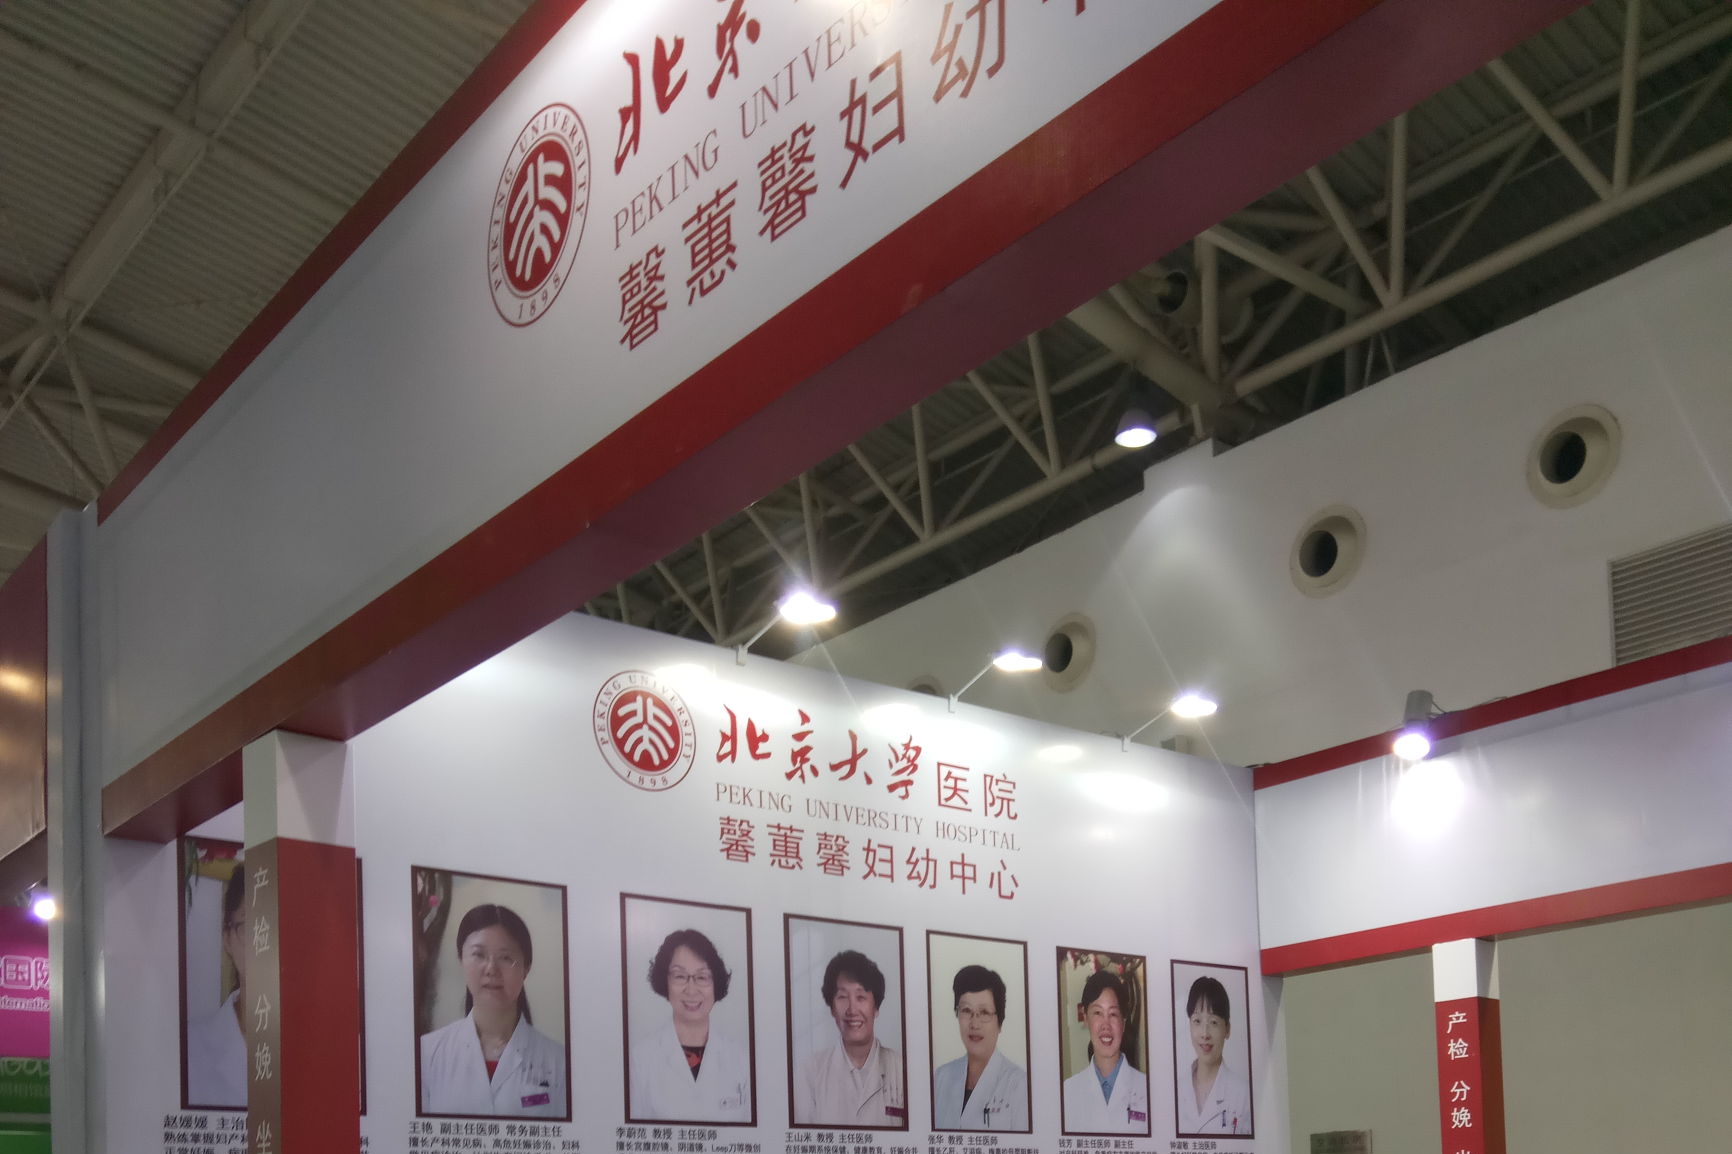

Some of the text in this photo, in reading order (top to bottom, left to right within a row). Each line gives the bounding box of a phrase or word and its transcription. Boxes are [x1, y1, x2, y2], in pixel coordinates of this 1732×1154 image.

[612, 127, 719, 250] PEKING
[618, 0, 1087, 351] 馨蕙馨妇幼
[715, 782, 1021, 853] PEKING UNIVERSITY HOSPITAL
[718, 816, 1019, 901] 馨蕙馨妇幼中心
[440, 1122, 500, 1137] 副主任医师
[506, 1124, 562, 1138] 常务副主任
[652, 1128, 672, 1141] 教授
[678, 1129, 717, 1142] 主任医师
[839, 1133, 873, 1144] 主任医师
[967, 1136, 998, 1146] 主任医师
